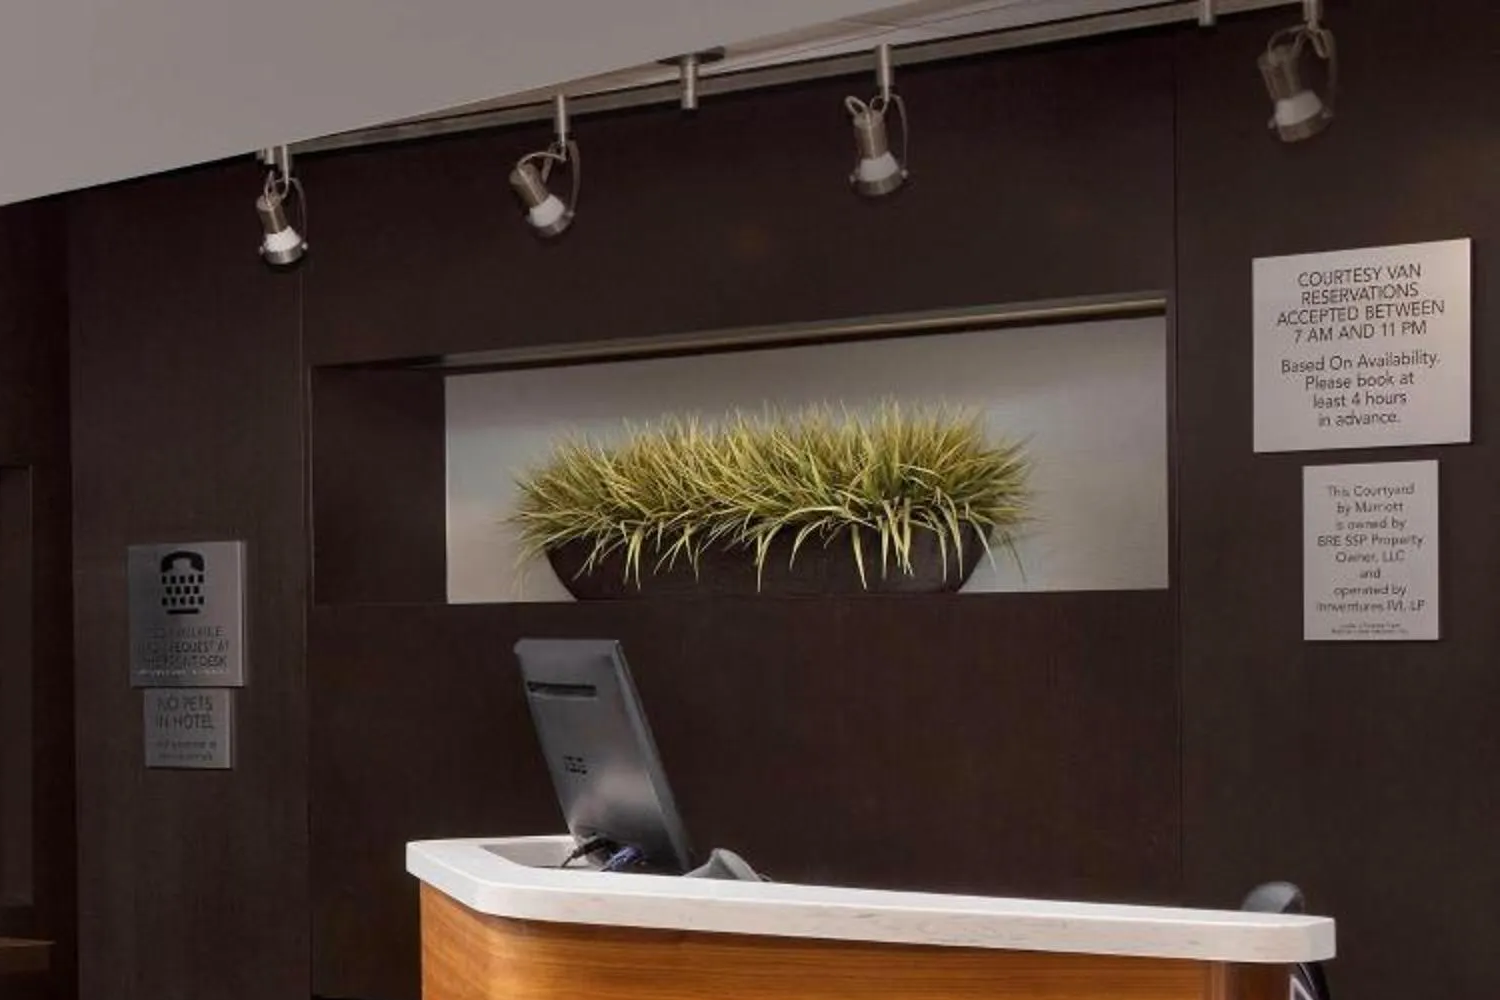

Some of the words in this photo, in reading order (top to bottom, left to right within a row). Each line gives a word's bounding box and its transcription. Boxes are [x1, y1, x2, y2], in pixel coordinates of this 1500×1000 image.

[1298, 266, 1383, 288] COURTESY
[1387, 263, 1421, 280] VAN
[1301, 282, 1419, 305] RESERVATIONS
[1277, 305, 1359, 327] ACCEPTED
[1366, 300, 1445, 319] BETWEEN
[1294, 329, 1302, 343] 7
[1307, 327, 1333, 343] AM
[1338, 325, 1375, 341] AND
[1381, 322, 1396, 338] 11
[1402, 320, 1427, 336] PM
[1281, 357, 1325, 374] Based
[1330, 355, 1353, 371] On
[1305, 376, 1351, 391] Please
[1357, 371, 1395, 388] book
[1400, 371, 1415, 386] at
[1313, 394, 1347, 410] least
[1351, 392, 1361, 407] 4
[1365, 390, 1408, 406] hours
[1318, 413, 1331, 428] in
[1354, 483, 1415, 499] Courtyard
[1337, 502, 1351, 516] by
[1355, 501, 1404, 514] Marriott
[1392, 516, 1408, 531] by
[1345, 534, 1368, 547] SSP
[1382, 550, 1406, 563] LLC
[1360, 568, 1381, 580] and
[1391, 584, 1408, 597] by
[157, 696, 179, 712] NO
[157, 713, 170, 729] IN
[173, 713, 214, 730] HOTEL
